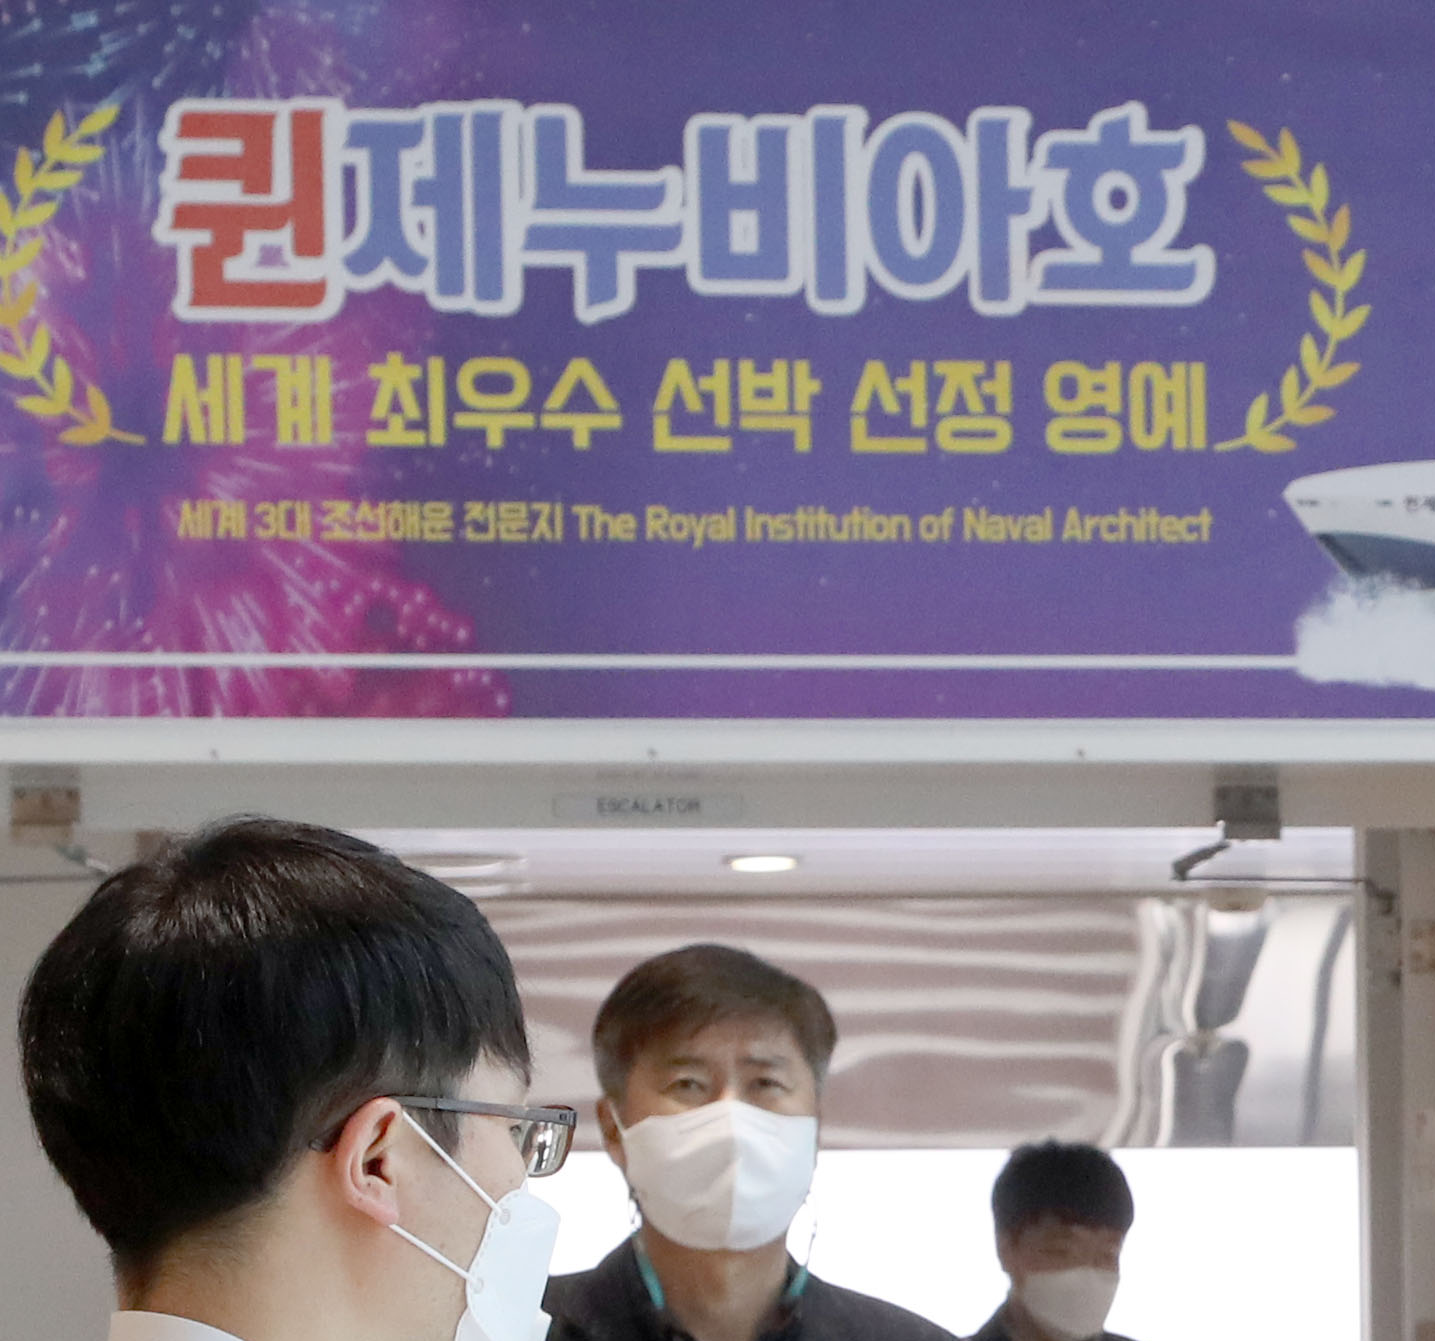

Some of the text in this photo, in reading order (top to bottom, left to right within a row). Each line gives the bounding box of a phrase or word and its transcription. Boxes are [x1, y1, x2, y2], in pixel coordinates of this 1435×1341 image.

[152, 98, 1216, 324] 퀸제누비아호
[164, 351, 1207, 454] 세계 최우수 선박 선정 영예
[177, 499, 1213, 549] 세계 3대 조선해운 전문지 The Royal Institution of Naval Architect
[597, 797, 701, 814] ESCALATOR
